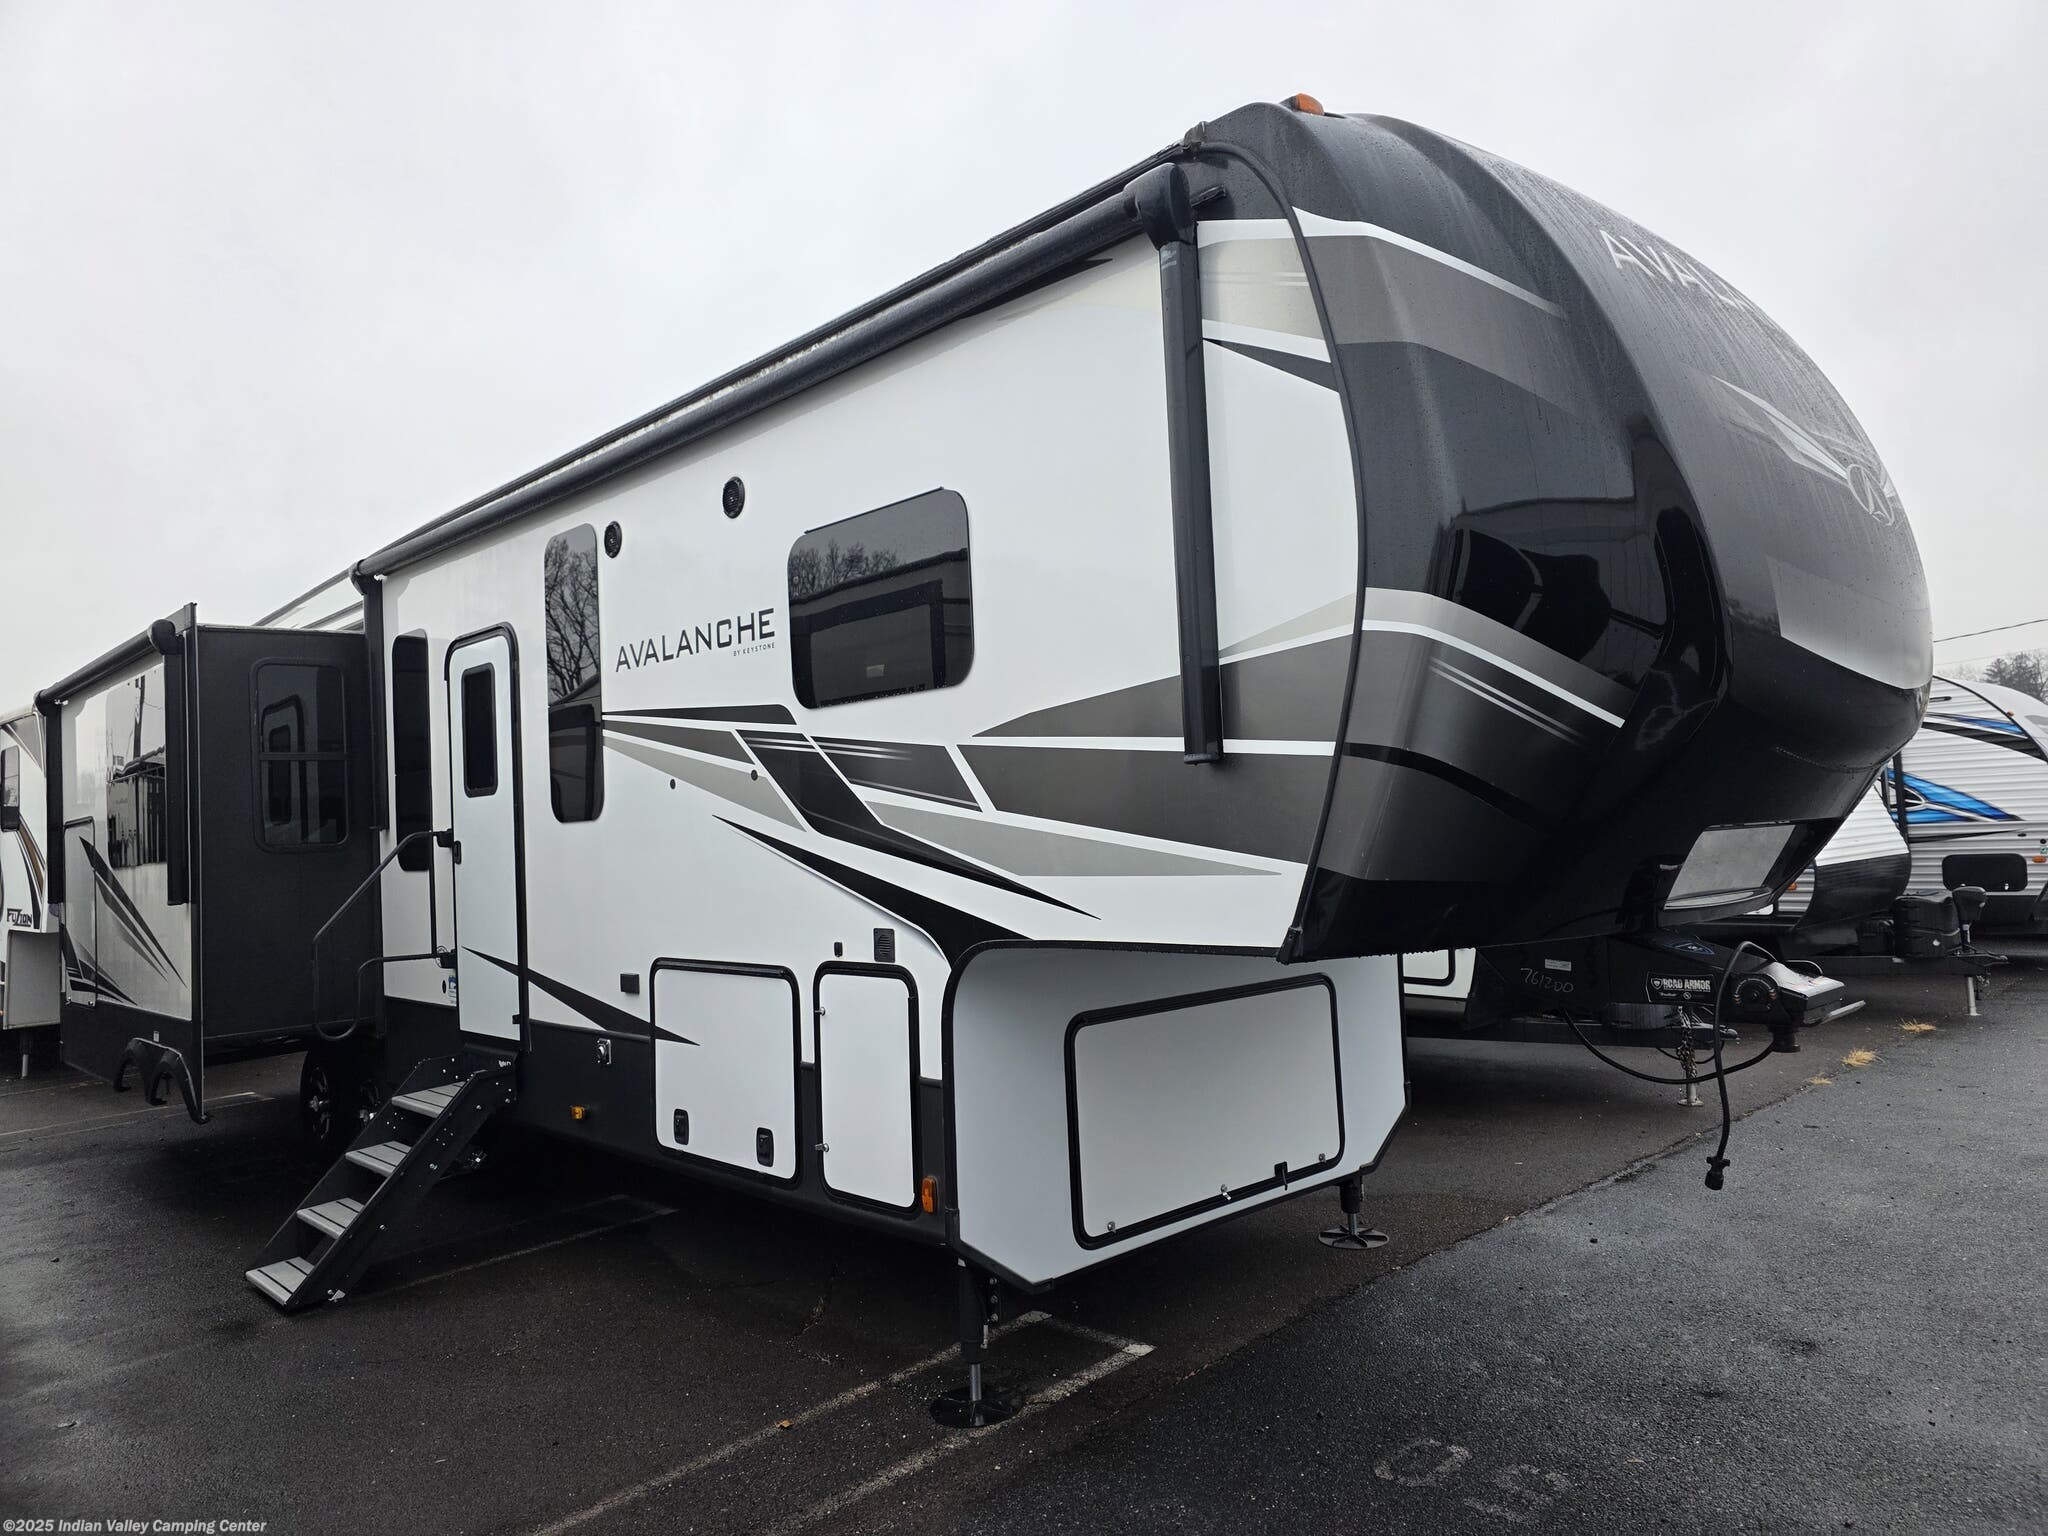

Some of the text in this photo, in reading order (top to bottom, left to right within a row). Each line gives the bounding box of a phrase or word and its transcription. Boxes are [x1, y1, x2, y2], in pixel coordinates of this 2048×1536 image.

[615, 608, 776, 673] AVALANCHE
[742, 642, 775, 654] KEYSTONE
[1662, 978, 1711, 992] ROAD ARMOR
